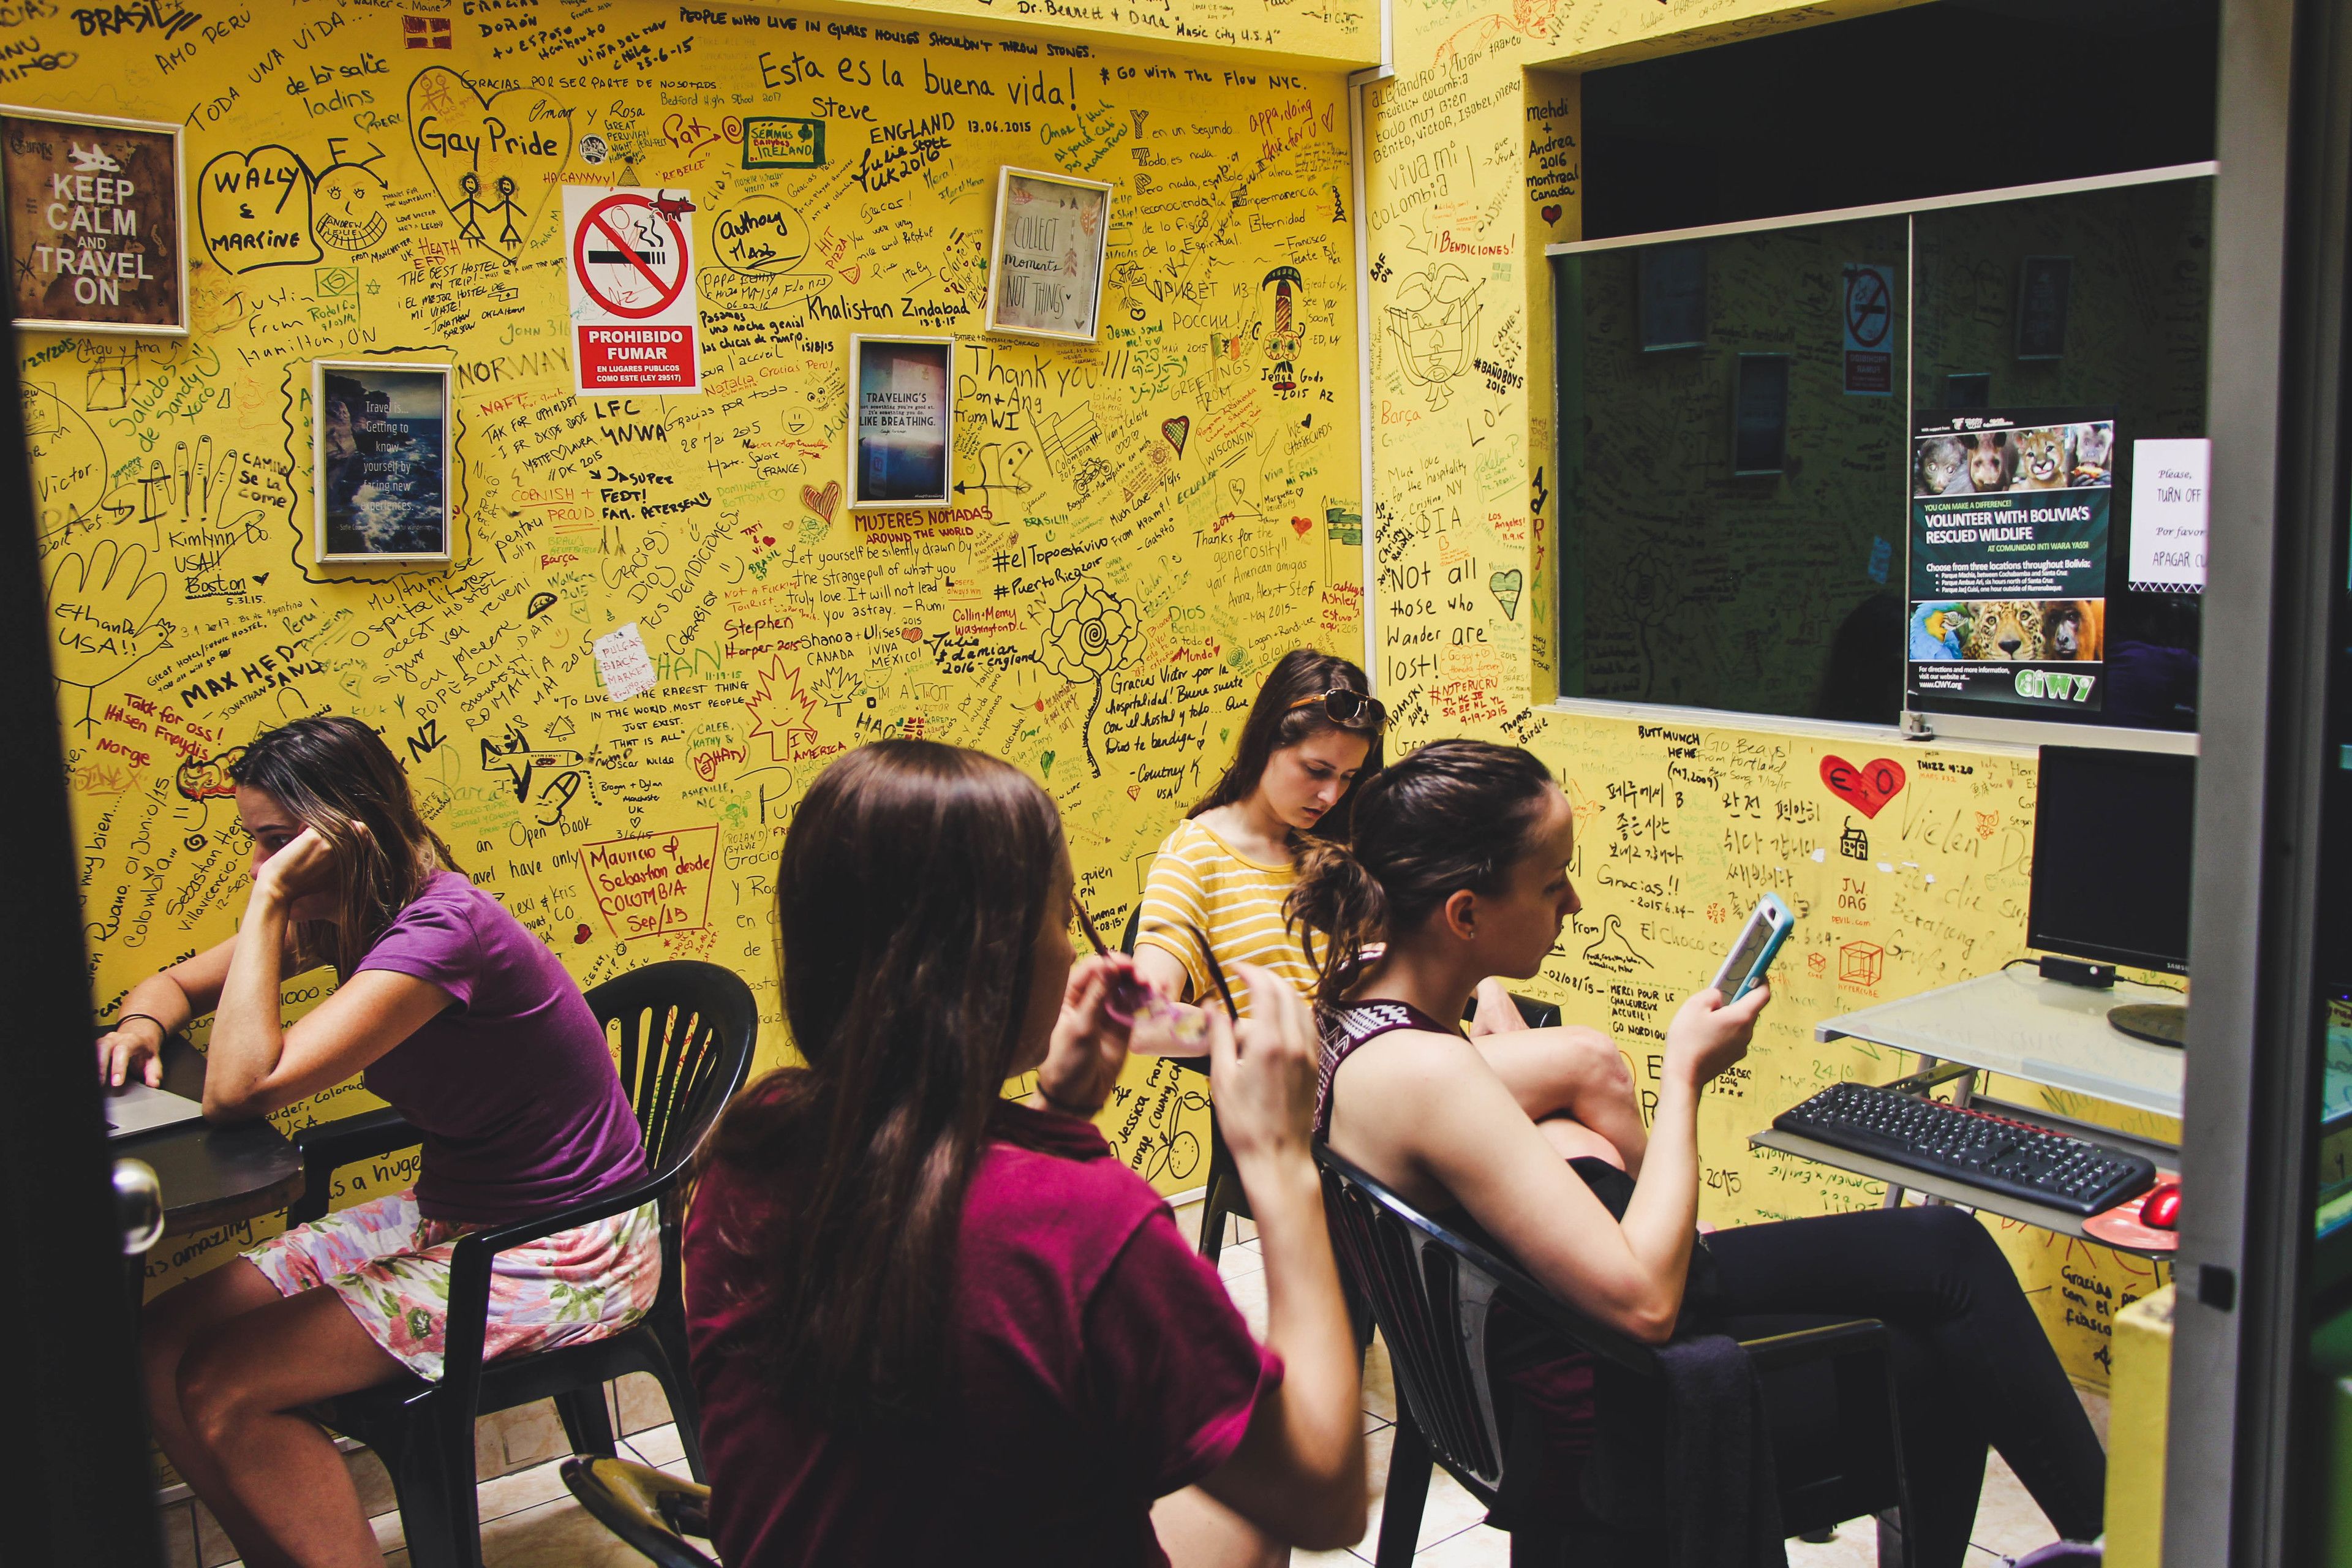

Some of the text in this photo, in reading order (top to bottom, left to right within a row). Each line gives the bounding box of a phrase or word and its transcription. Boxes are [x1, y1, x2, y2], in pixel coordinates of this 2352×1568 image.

[1018, 1, 1169, 28] Dr. Bennett Dana
[680, 7, 727, 26] PEOPLE
[732, 14, 761, 26] WHO
[767, 15, 797, 31] LIVE
[805, 21, 821, 32] IN
[827, 23, 867, 40] GLASS
[875, 29, 920, 45] HOUSES
[1000, 40, 1038, 56] THROW
[155, 42, 196, 75] AMO
[184, 48, 285, 130] TODA UNA
[758, 51, 825, 89] Esta
[838, 57, 872, 86] es
[882, 59, 904, 87] la
[923, 58, 995, 96] buena
[1007, 67, 1077, 111] vida!
[811, 97, 877, 122] Steve
[870, 112, 955, 145] ENGLAND
[968, 121, 1031, 134] 13.06.2015
[418, 116, 557, 172] Gay Pride
[1529, 134, 1575, 158] Andrea
[1541, 153, 1567, 169] 2016
[54, 173, 135, 205] KEEP
[215, 167, 299, 214] WALLY
[1531, 184, 1574, 202] Canada
[48, 203, 136, 236] CALM
[1014, 215, 1059, 251] COLLECT
[78, 236, 106, 250] AND
[36, 246, 153, 280] TRAVEL
[75, 277, 119, 306] ON
[1006, 276, 1065, 319] NOT THINGS
[806, 294, 970, 320] Khalistan Zindabad
[348, 326, 377, 344] ON
[589, 331, 683, 344] PROHIBIDO
[607, 347, 668, 360] FUMAR
[458, 347, 571, 389] NORWAY
[965, 345, 1047, 390] Thank
[959, 374, 991, 407] Don
[1486, 379, 1506, 394] 2016
[366, 401, 390, 413] Travel
[867, 393, 926, 402] TRAVELING'S
[595, 399, 641, 419] LFC
[366, 421, 409, 435] Getting to
[859, 417, 935, 426] LIKE BREATHING.
[376, 441, 399, 452] know
[364, 462, 410, 474] yourself by
[2158, 469, 2192, 479] Please,
[393, 482, 410, 491] new
[2157, 487, 2201, 502] TURN OFF
[1976, 500, 2011, 509] DIFFERENCE!
[854, 510, 924, 532] MUJERES
[1924, 505, 2090, 527] VOLUNTEER WITH BOLIVIA'S
[866, 527, 974, 545] AROUND THE WORLD
[1926, 526, 2033, 544] RESCUED WILDLIFE
[2156, 527, 2173, 535] Por
[1996, 543, 2036, 552] COMUNIDAD
[2051, 541, 2071, 550] WARA
[1926, 559, 2090, 572] Choose from three locations throughout Bolivia:
[2152, 551, 2190, 567] APAGAR
[1449, 557, 1476, 584] all
[186, 576, 246, 595] Boston
[1390, 594, 1473, 617] those who
[1452, 627, 1487, 646] are
[1389, 654, 1438, 686] lost!
[622, 722, 648, 733] JUST
[97, 737, 151, 767] Norge
[408, 720, 447, 766] NZ
[559, 817, 593, 838] Book
[1839, 894, 1866, 911] ORG
[1610, 985, 1675, 1003] MERCI POUR LE
[1611, 997, 1657, 1011] CHALEUREUX
